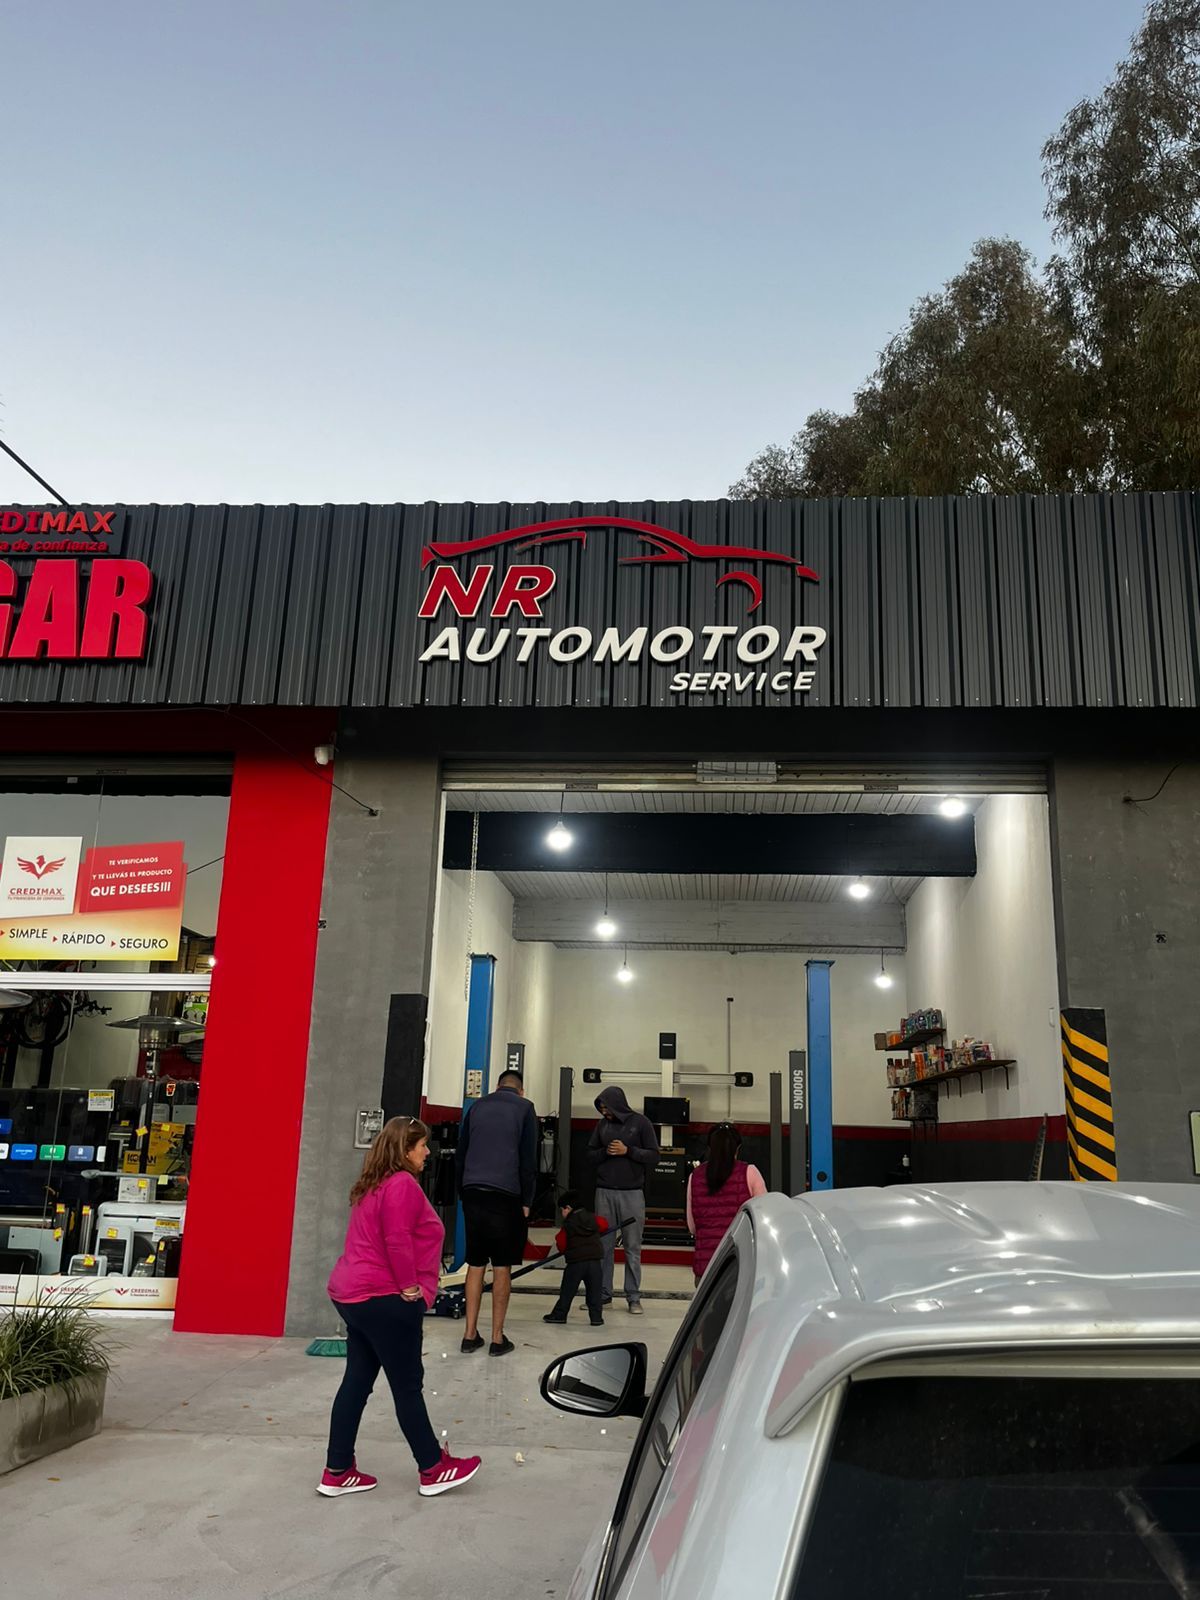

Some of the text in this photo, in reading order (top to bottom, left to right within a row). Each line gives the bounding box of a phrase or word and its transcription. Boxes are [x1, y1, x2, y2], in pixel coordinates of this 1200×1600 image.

[0, 511, 115, 533] DIMAX
[11, 539, 31, 552] de
[34, 539, 108, 552] confianza
[418, 565, 556, 618] NR
[418, 626, 827, 663] AUTOMOTOR
[669, 671, 816, 693] SERVICE
[108, 856, 159, 867] TE VERIFICAMOS
[98, 872, 105, 880] TE
[129, 870, 136, 878] EL
[137, 868, 173, 877] PRODUCTO
[9, 887, 63, 895] CREDIMAX
[90, 885, 116, 897] QUE
[9, 928, 169, 949] SIMPLE RÁPIDO SEGURO
[793, 1069, 804, 1110] 5000KG
